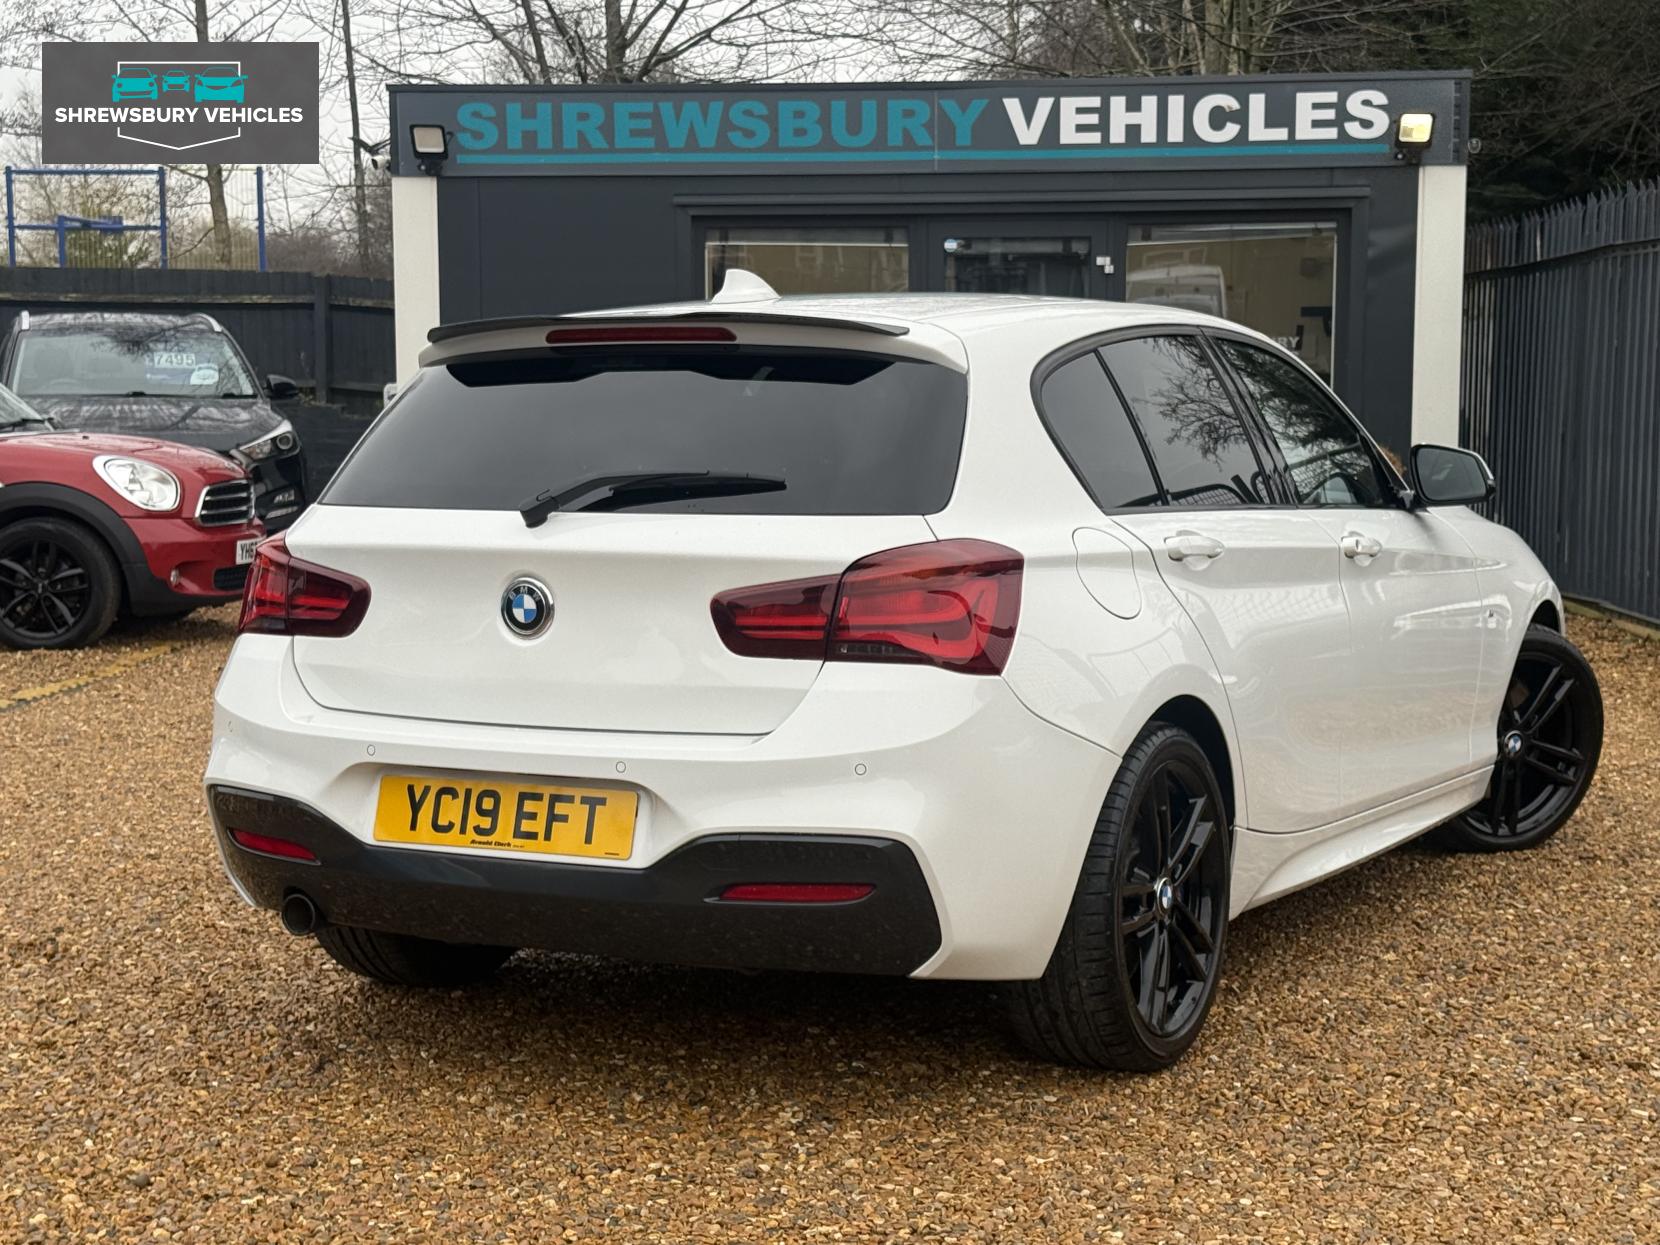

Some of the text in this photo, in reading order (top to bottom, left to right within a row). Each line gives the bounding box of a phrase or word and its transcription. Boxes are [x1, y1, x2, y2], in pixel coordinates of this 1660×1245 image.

[456, 89, 1390, 150] SHREWSBURY VEHICLES
[508, 586, 541, 601] BMW
[406, 783, 607, 845] YC19 EFT
